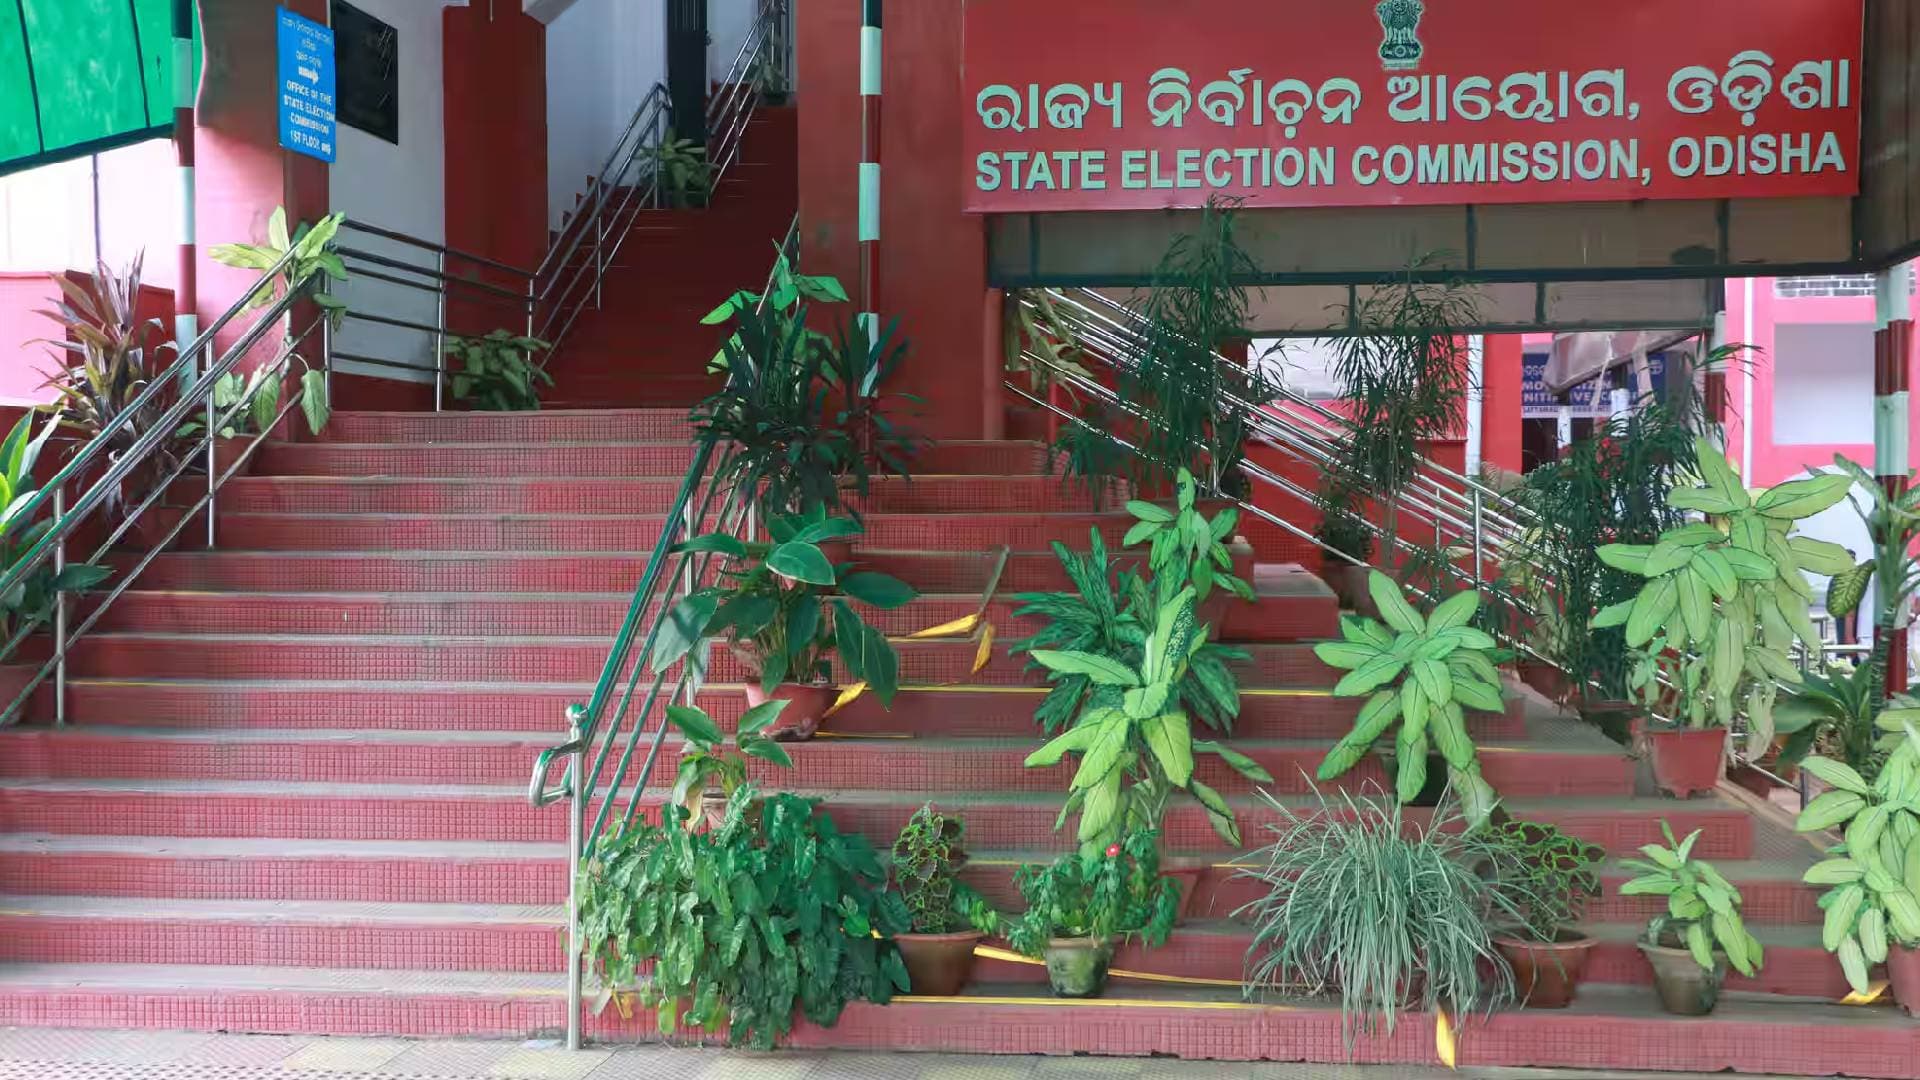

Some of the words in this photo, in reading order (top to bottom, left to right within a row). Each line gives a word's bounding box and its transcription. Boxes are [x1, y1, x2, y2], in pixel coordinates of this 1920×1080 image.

[286, 80, 310, 97] OFFICE
[320, 92, 332, 106] THE
[977, 82, 1122, 132] ରାଜ୍ୟ
[284, 94, 304, 111] STATE
[305, 103, 335, 122] ELECTION
[290, 112, 329, 136] COMMISSION
[976, 150, 1106, 191] STATE
[1121, 147, 1335, 189] ELECTION
[1352, 138, 1651, 185] COMMISSION,
[1668, 131, 1846, 177] ODISHA
